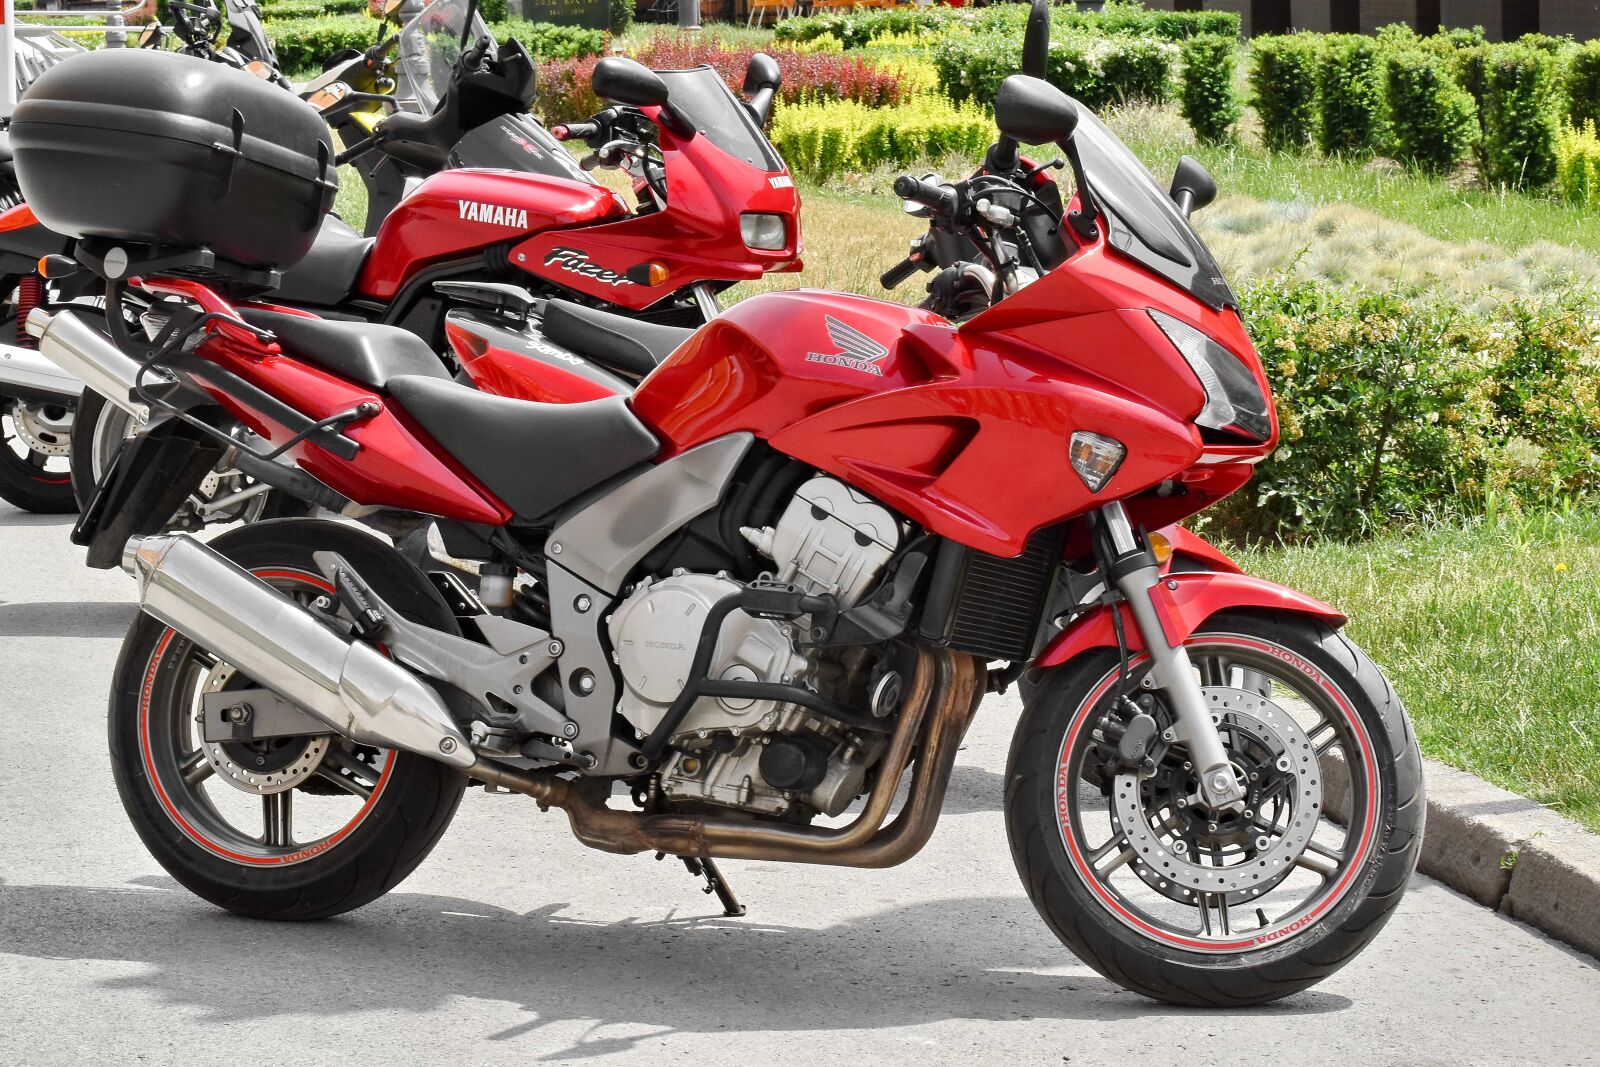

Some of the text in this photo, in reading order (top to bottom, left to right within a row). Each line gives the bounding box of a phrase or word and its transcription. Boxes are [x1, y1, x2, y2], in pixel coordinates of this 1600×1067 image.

[458, 199, 528, 229] YAMAHA
[805, 351, 883, 377] HONDA
[1270, 646, 1321, 684] HONDA
[143, 656, 160, 709] HONDA
[1058, 767, 1069, 824] HONDA
[281, 840, 330, 864] HONDA
[1256, 914, 1312, 944] HONDA
